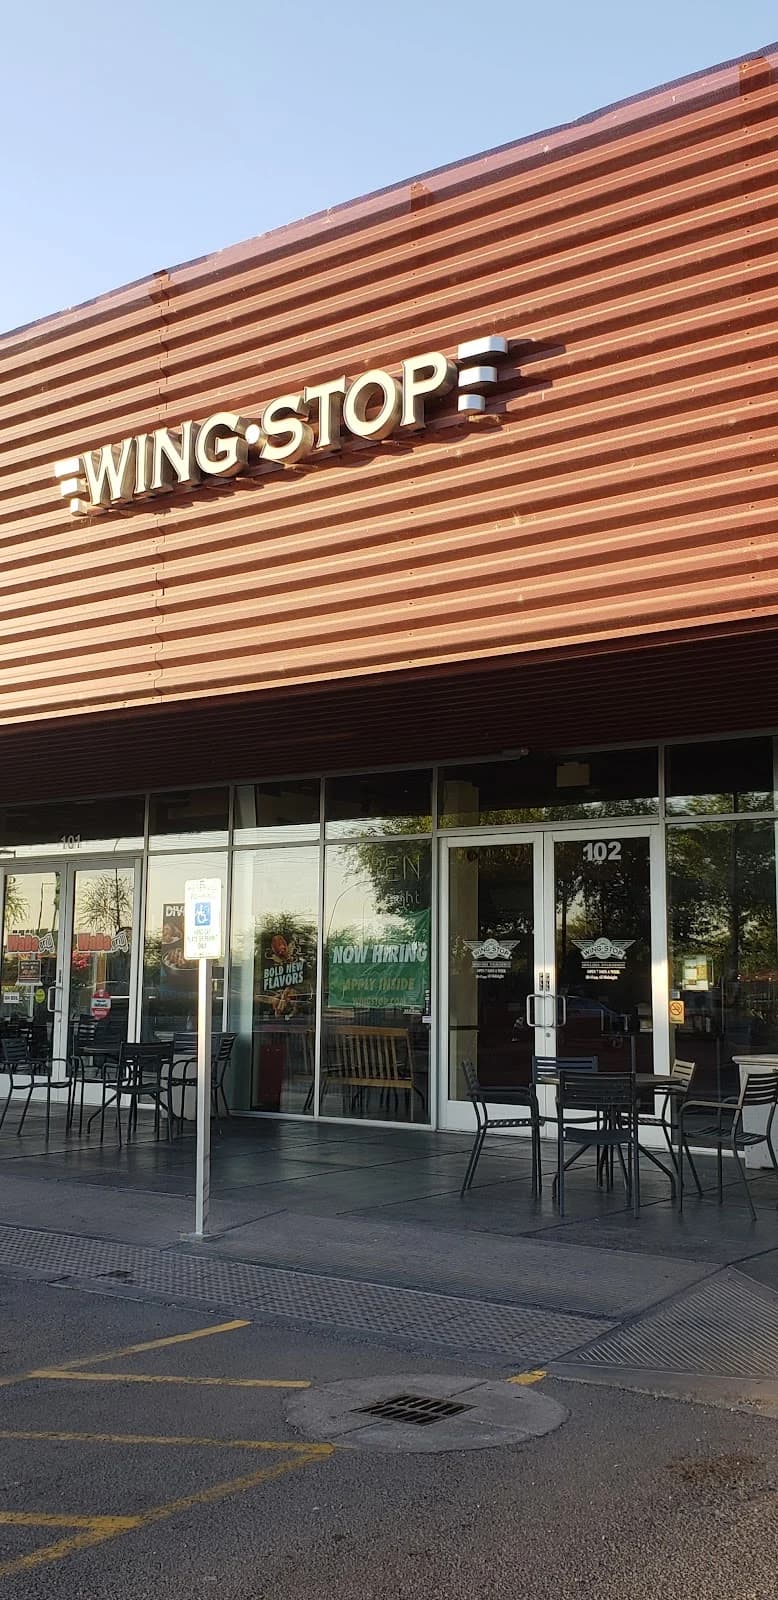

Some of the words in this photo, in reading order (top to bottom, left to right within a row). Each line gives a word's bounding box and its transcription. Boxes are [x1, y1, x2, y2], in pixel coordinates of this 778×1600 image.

[60, 834, 81, 849] 101
[582, 841, 622, 861] 102
[165, 905, 185, 917] DIV
[332, 945, 369, 964] NOW
[372, 941, 428, 963] HIRING
[263, 966, 284, 979] BOLD
[286, 961, 304, 973] NEW
[263, 971, 304, 991] FLAVORS
[343, 978, 376, 991] APPLY
[381, 978, 416, 991] INSIDE
